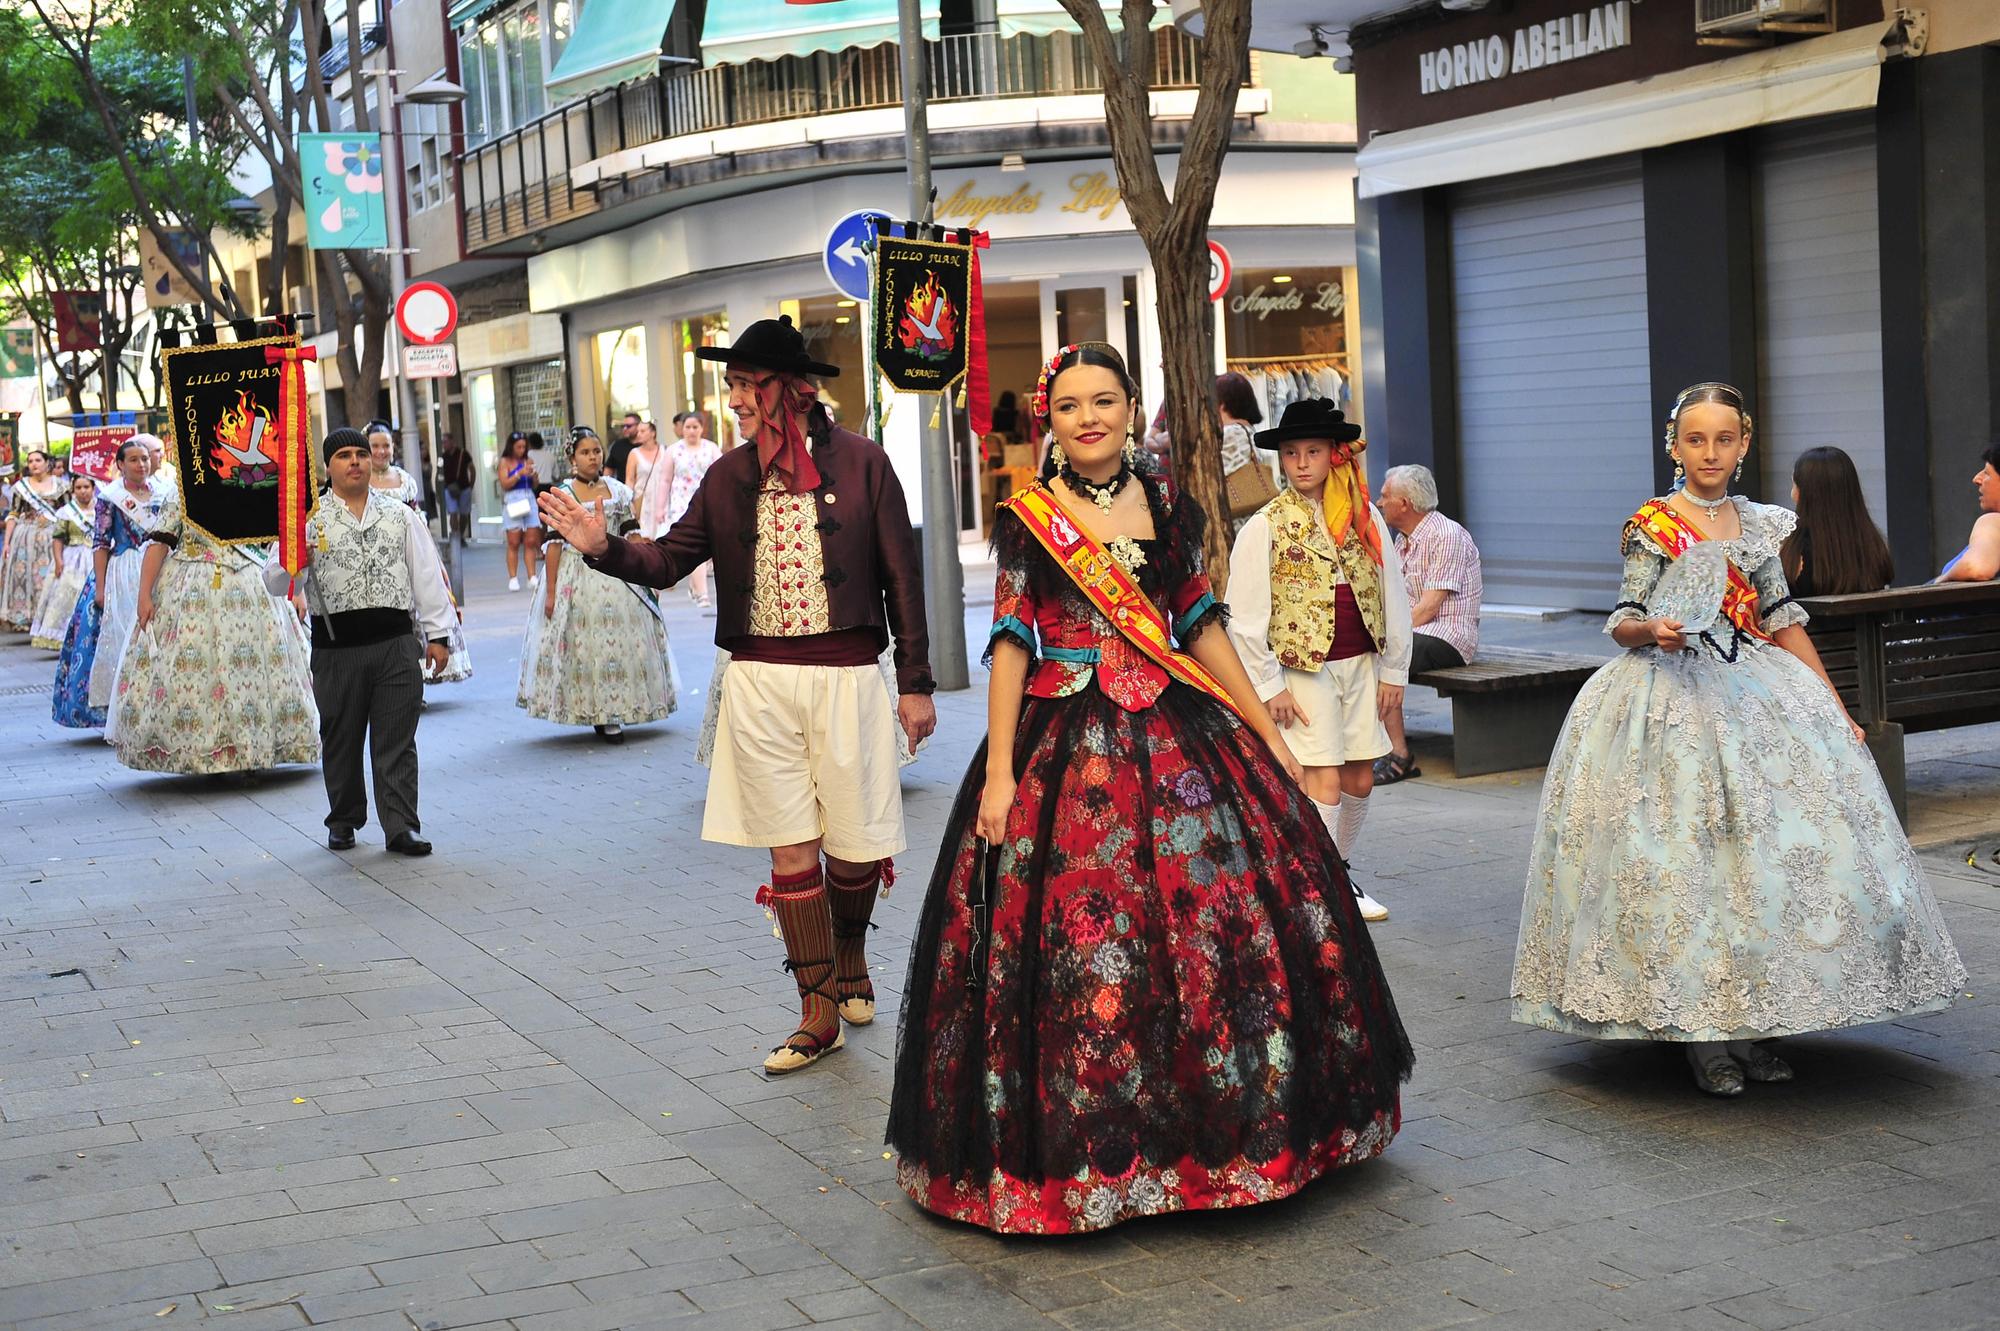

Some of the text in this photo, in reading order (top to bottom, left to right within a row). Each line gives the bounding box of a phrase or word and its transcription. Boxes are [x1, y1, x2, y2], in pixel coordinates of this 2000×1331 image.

[1420, 1, 1631, 94] HORNO ABELLAN
[889, 250, 960, 266] LILLO JUAN
[884, 268, 895, 349] FOGUERA
[186, 366, 282, 386] LILLO JUAN
[184, 395, 206, 486] FOGUERA
